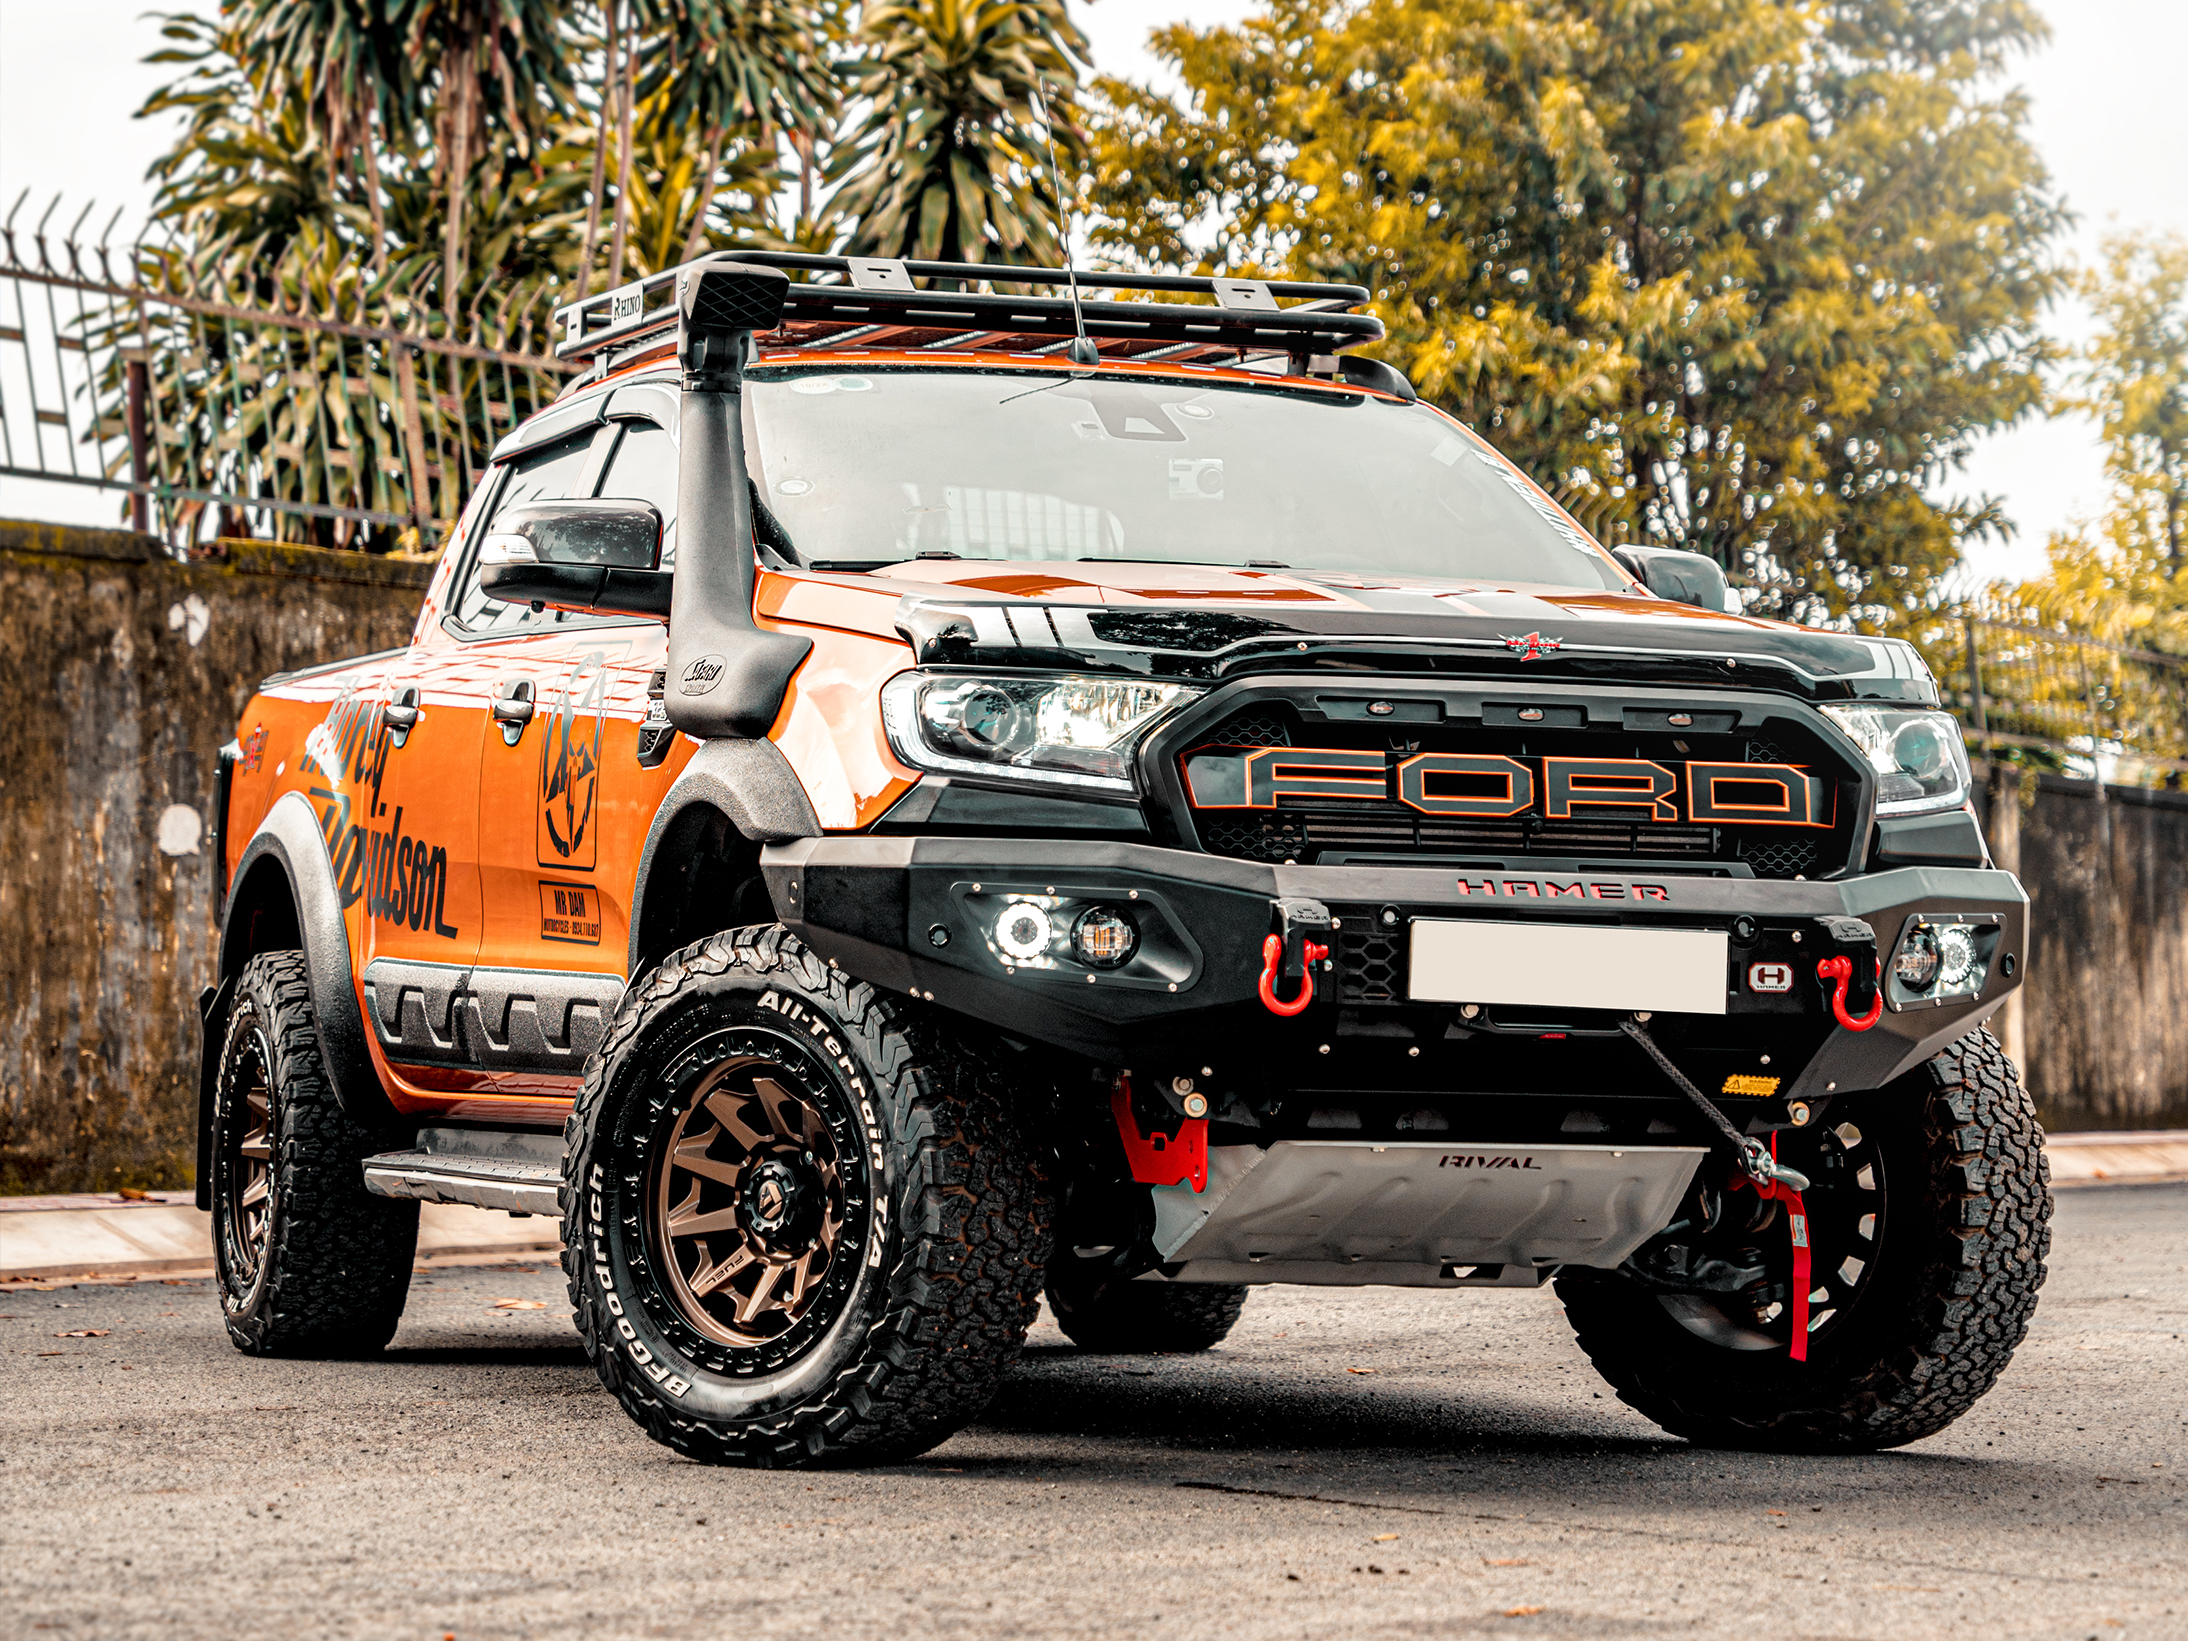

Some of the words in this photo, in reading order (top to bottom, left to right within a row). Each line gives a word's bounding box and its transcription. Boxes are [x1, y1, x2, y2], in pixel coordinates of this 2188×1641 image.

[614, 294, 641, 321] RHINO
[1244, 747, 1812, 827] FORD
[309, 786, 459, 940] Davidson
[554, 889, 567, 916] MR
[1457, 878, 1671, 901] HAMER
[757, 990, 884, 1171] All-Terrain
[868, 1194, 889, 1268] T/A
[1438, 1155, 1542, 1170] RIVAL
[589, 1162, 692, 1398] BFGoodrich
[705, 1254, 745, 1285] FUEL
